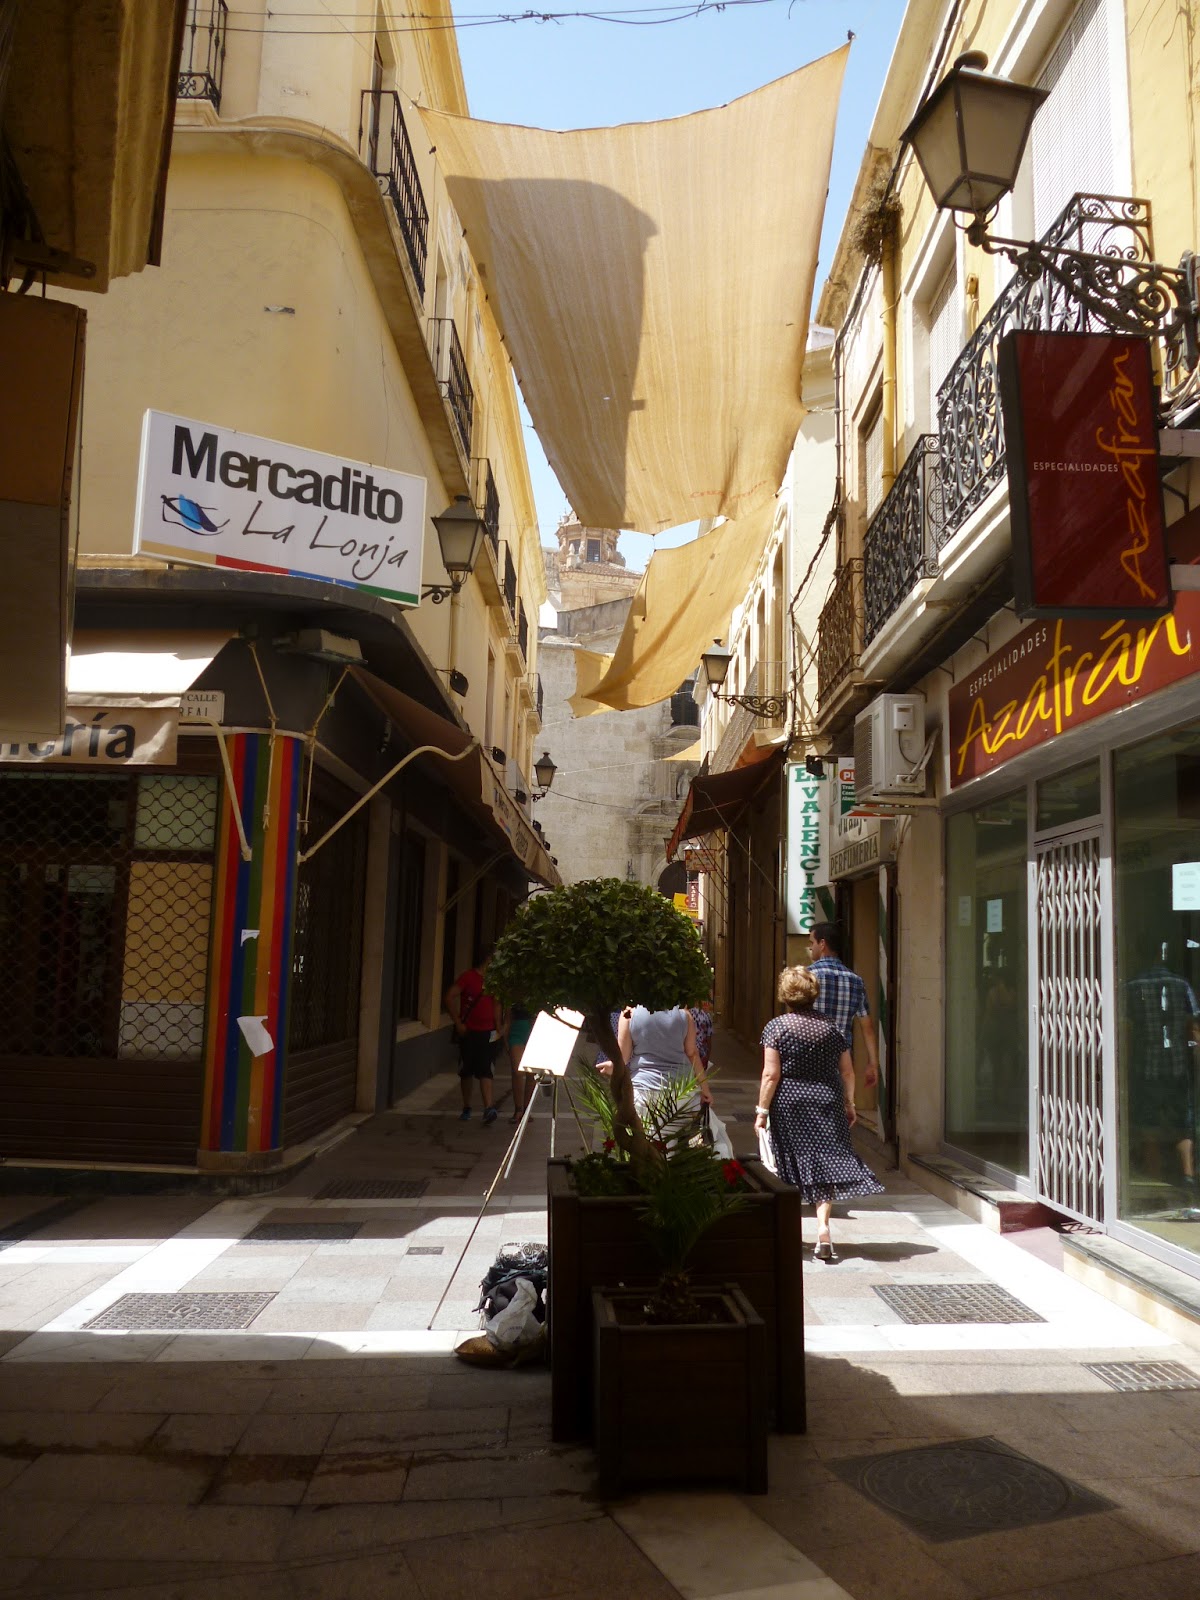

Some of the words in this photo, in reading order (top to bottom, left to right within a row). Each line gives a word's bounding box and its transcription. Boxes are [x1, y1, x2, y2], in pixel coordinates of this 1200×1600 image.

[171, 424, 404, 524] Mercadito
[1033, 461, 1119, 473] ESPECIALIDADES
[1096, 347, 1158, 600] Azafrán
[242, 500, 296, 544] La
[309, 515, 409, 581] Lonja
[187, 693, 218, 702] CALLE
[957, 612, 1192, 776] Azafrán
[969, 627, 1048, 697] ESPECIALIDADES
